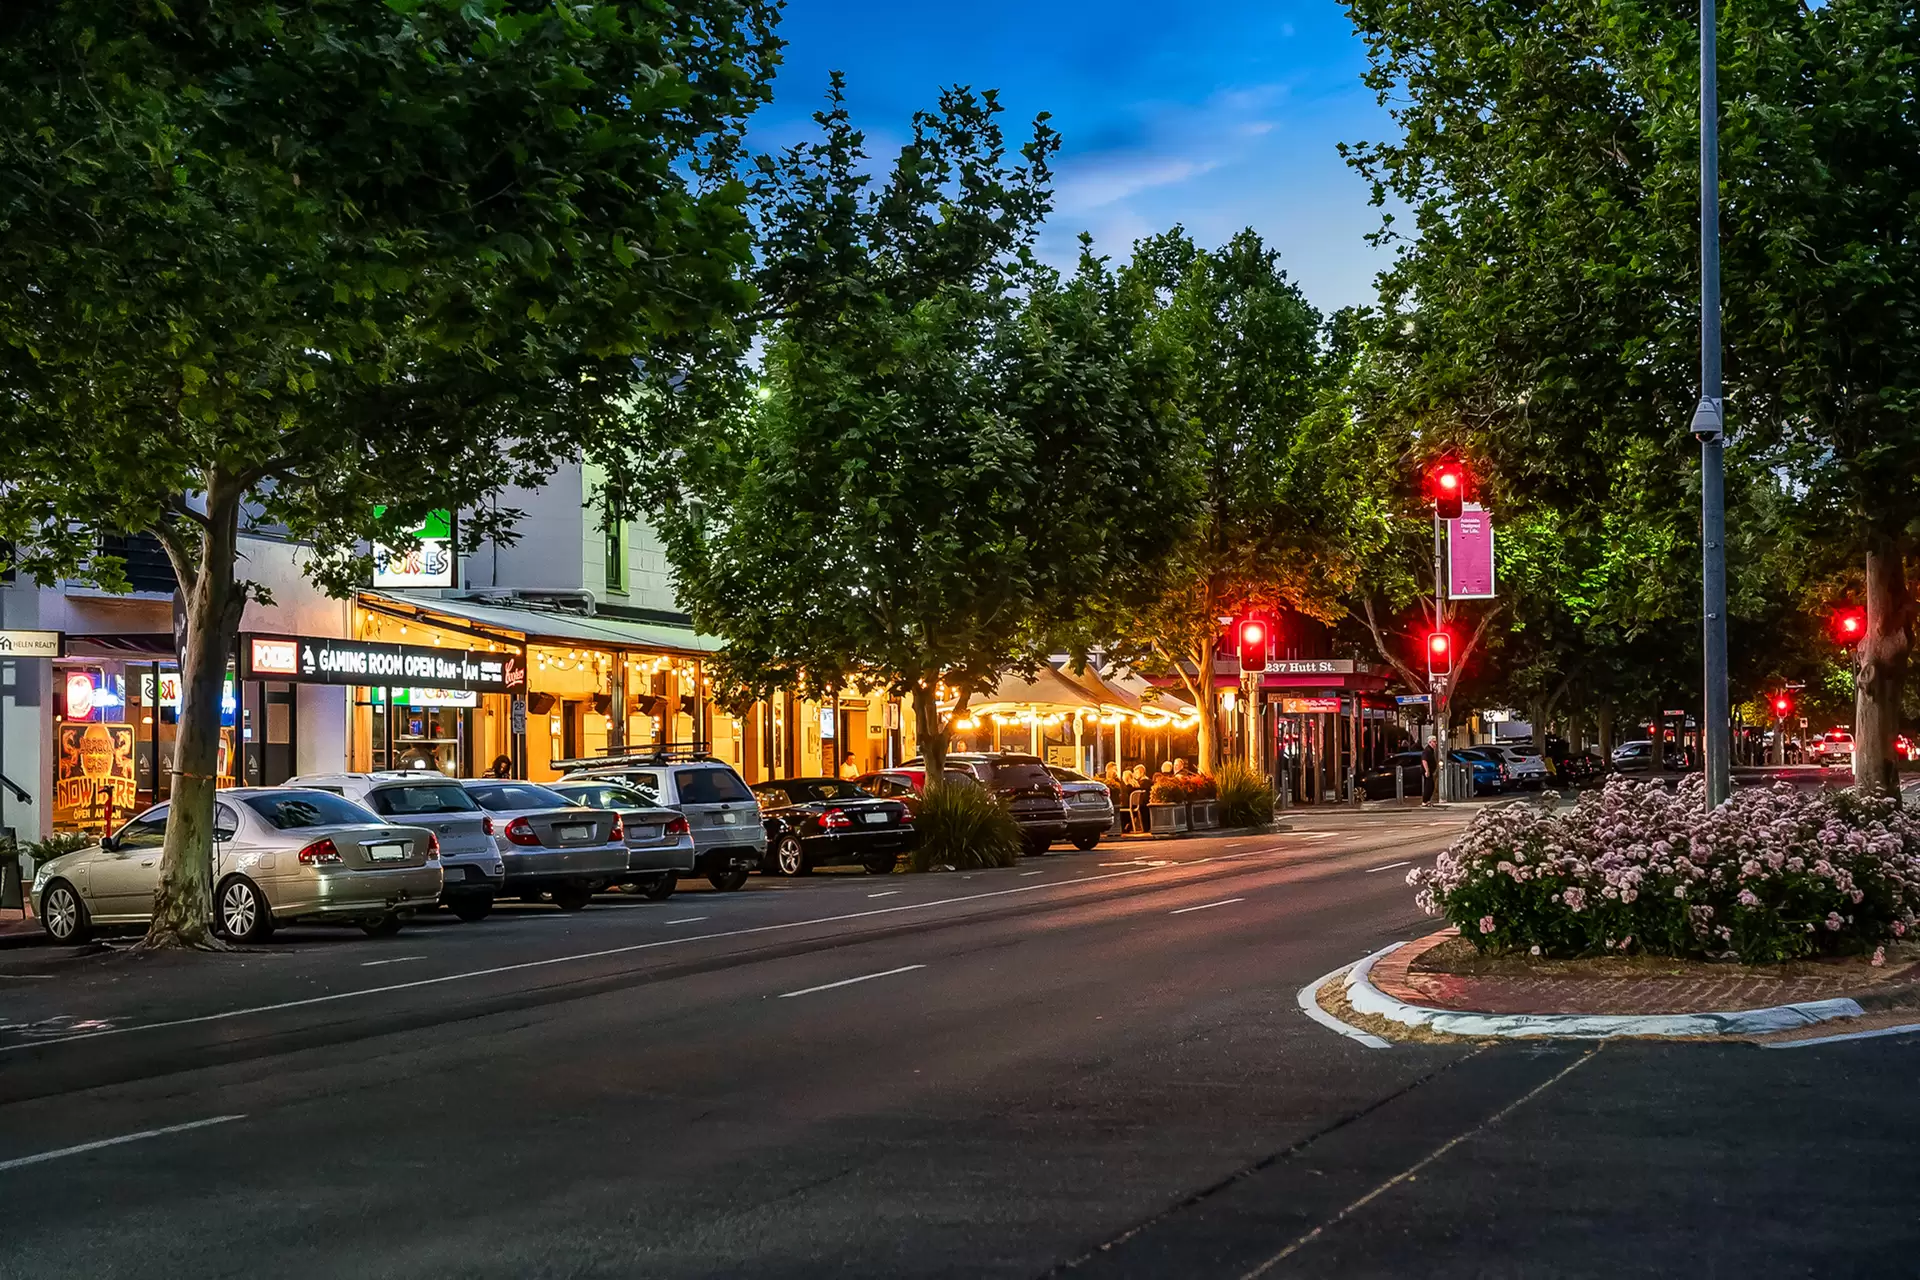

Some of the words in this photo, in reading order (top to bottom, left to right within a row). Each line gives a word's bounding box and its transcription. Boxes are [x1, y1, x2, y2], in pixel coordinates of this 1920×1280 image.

[13, 640, 34, 649] HELEN
[34, 641, 57, 649] REALTY
[319, 649, 367, 674] GAMING
[368, 652, 403, 676] ROOM
[404, 655, 436, 678] OPEN
[1267, 663, 1287, 672] 237
[1289, 662, 1317, 672] Hutt
[1319, 661, 1336, 672] St.
[514, 702, 525, 711] 2P
[57, 777, 94, 811] NOW
[73, 807, 91, 820] OPEN
